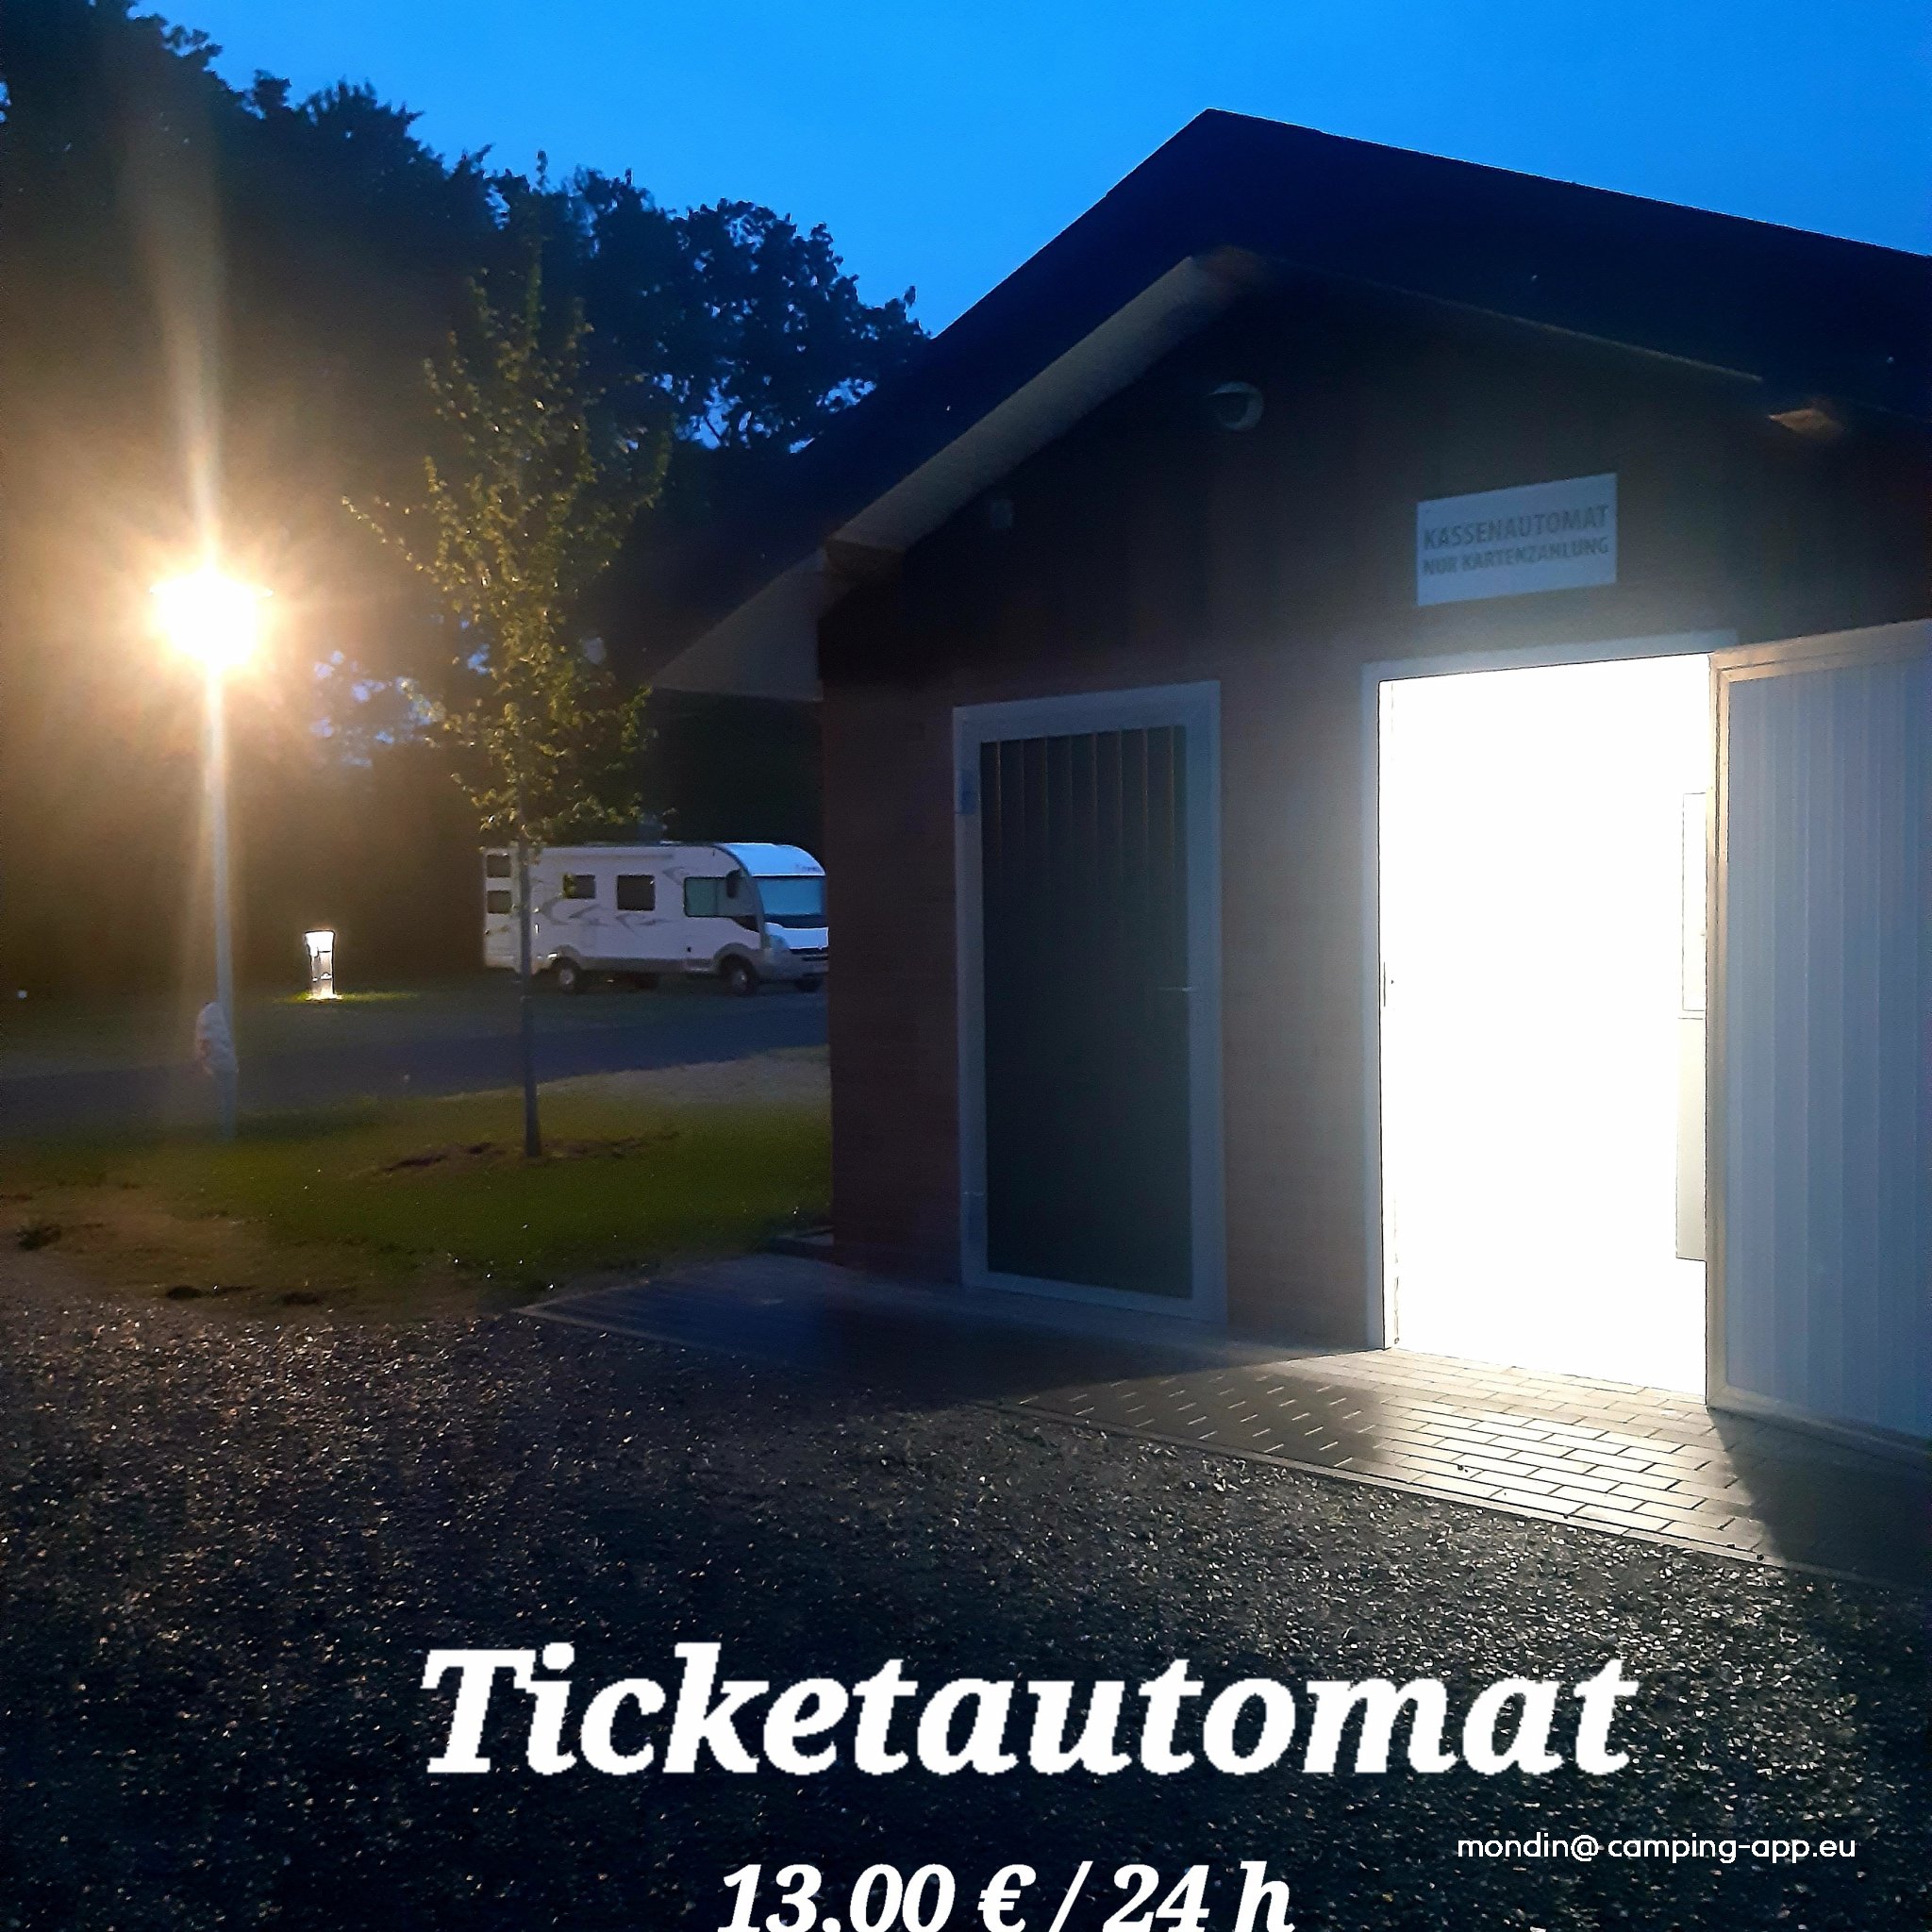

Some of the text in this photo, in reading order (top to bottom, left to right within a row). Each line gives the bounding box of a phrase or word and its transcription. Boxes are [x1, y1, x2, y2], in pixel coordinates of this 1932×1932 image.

[1422, 504, 1609, 550] KASSENAUTOMAT
[1422, 536, 1609, 575] NUR KARTENZAHLUNG
